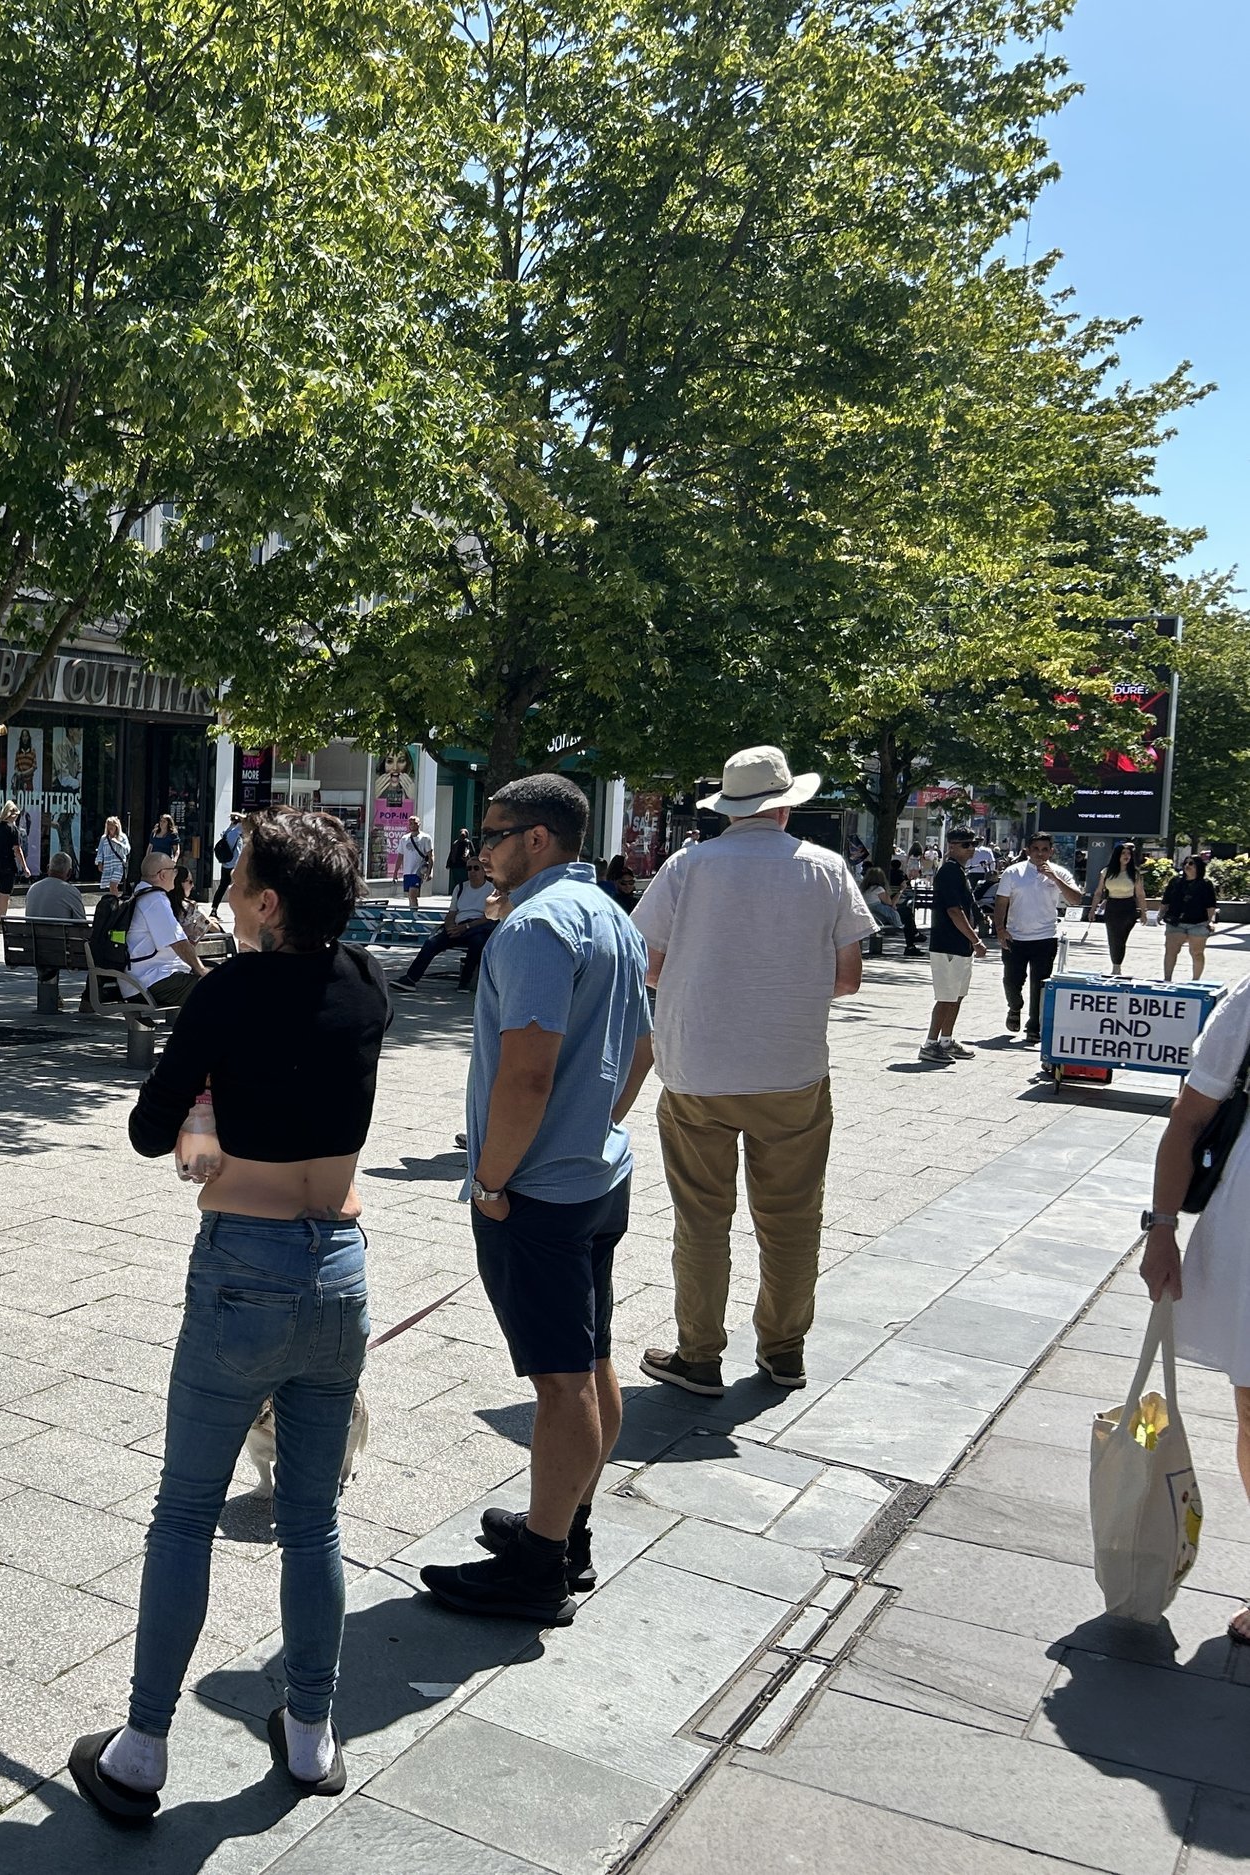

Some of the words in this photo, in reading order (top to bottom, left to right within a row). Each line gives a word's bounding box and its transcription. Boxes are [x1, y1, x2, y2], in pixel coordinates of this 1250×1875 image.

[242, 756, 260, 769] SAVE
[241, 770, 260, 781] MORE
[17, 789, 81, 815] OUTFITTERS
[379, 811, 408, 820] POP-IN
[1069, 993, 1118, 1014] FREE
[1128, 997, 1186, 1019] BIBLE
[1099, 1018, 1152, 1038] AND
[1059, 1036, 1189, 1065] LITERATURE
